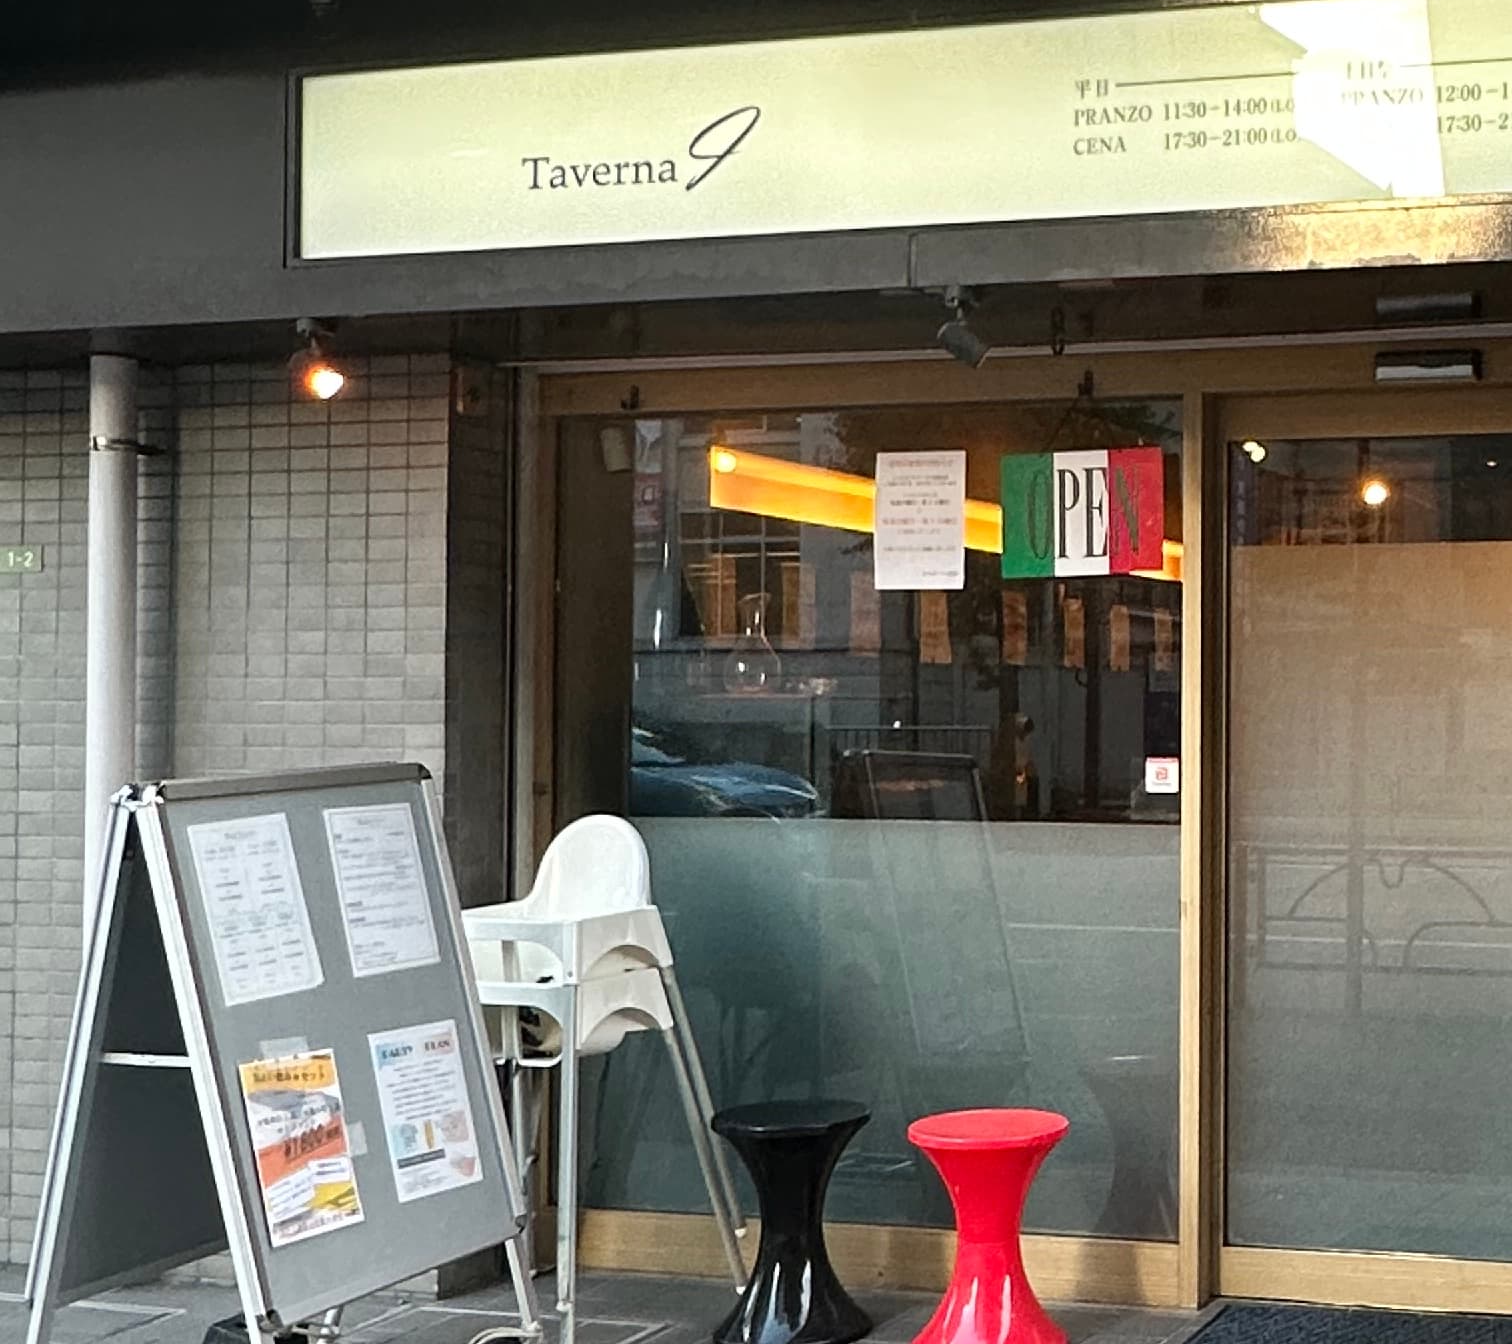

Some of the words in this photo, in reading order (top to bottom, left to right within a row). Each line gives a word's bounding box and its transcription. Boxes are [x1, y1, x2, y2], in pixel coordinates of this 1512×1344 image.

[1073, 103, 1154, 127] PRANZO
[1072, 135, 1128, 156] CENA
[521, 155, 678, 190] Taverna
[1026, 464, 1142, 561] OPEN
[8, 550, 35, 568] 1-2
